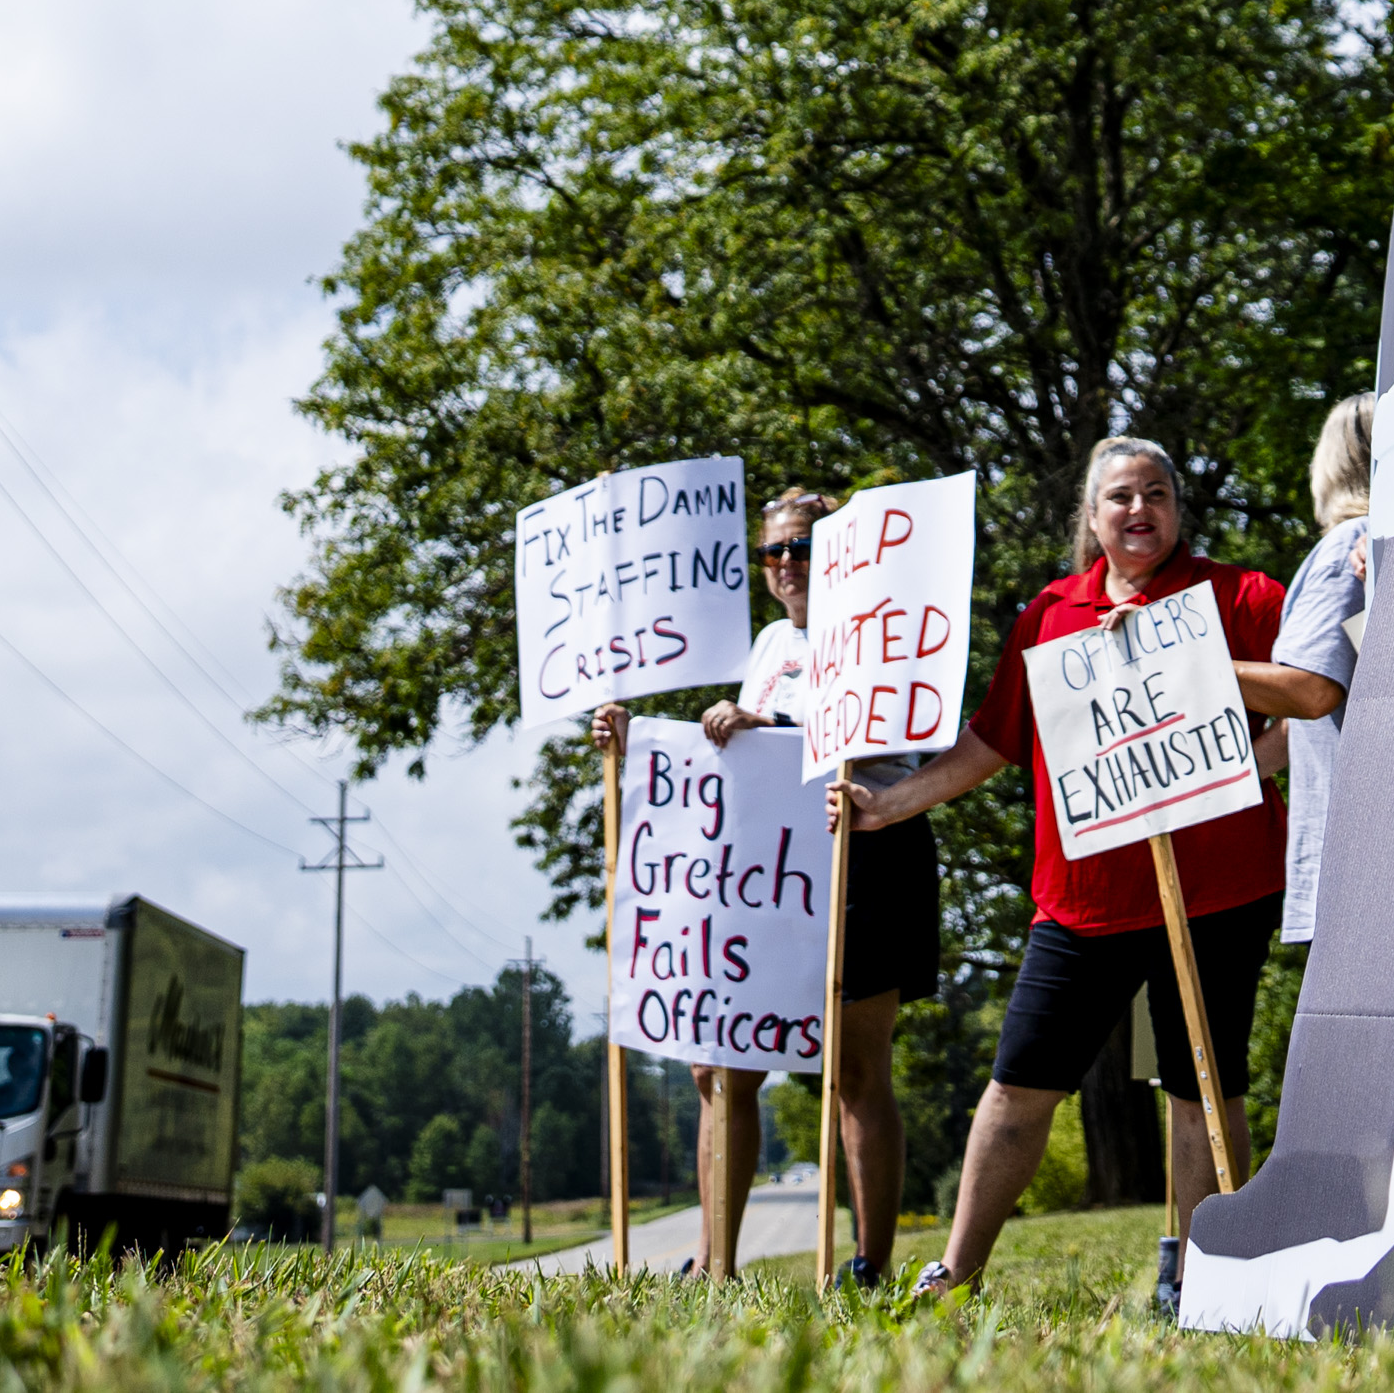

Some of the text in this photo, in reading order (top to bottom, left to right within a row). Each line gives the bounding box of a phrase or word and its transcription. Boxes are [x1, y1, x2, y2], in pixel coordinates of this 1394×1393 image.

[523, 475, 737, 578] FIX THE DAMN
[824, 509, 913, 589] HELP
[544, 541, 744, 638] STAFFING
[539, 615, 688, 699] CRISIS
[809, 597, 951, 700] WANTED
[1062, 593, 1208, 691] OFFICERS
[807, 681, 943, 764] NEEDED
[1090, 671, 1177, 746] ARE
[647, 750, 725, 841] Big
[1058, 707, 1249, 825] EXHAUSTED
[630, 820, 815, 917] Gretch
[629, 906, 751, 983] Fails
[638, 988, 822, 1059] Officers
